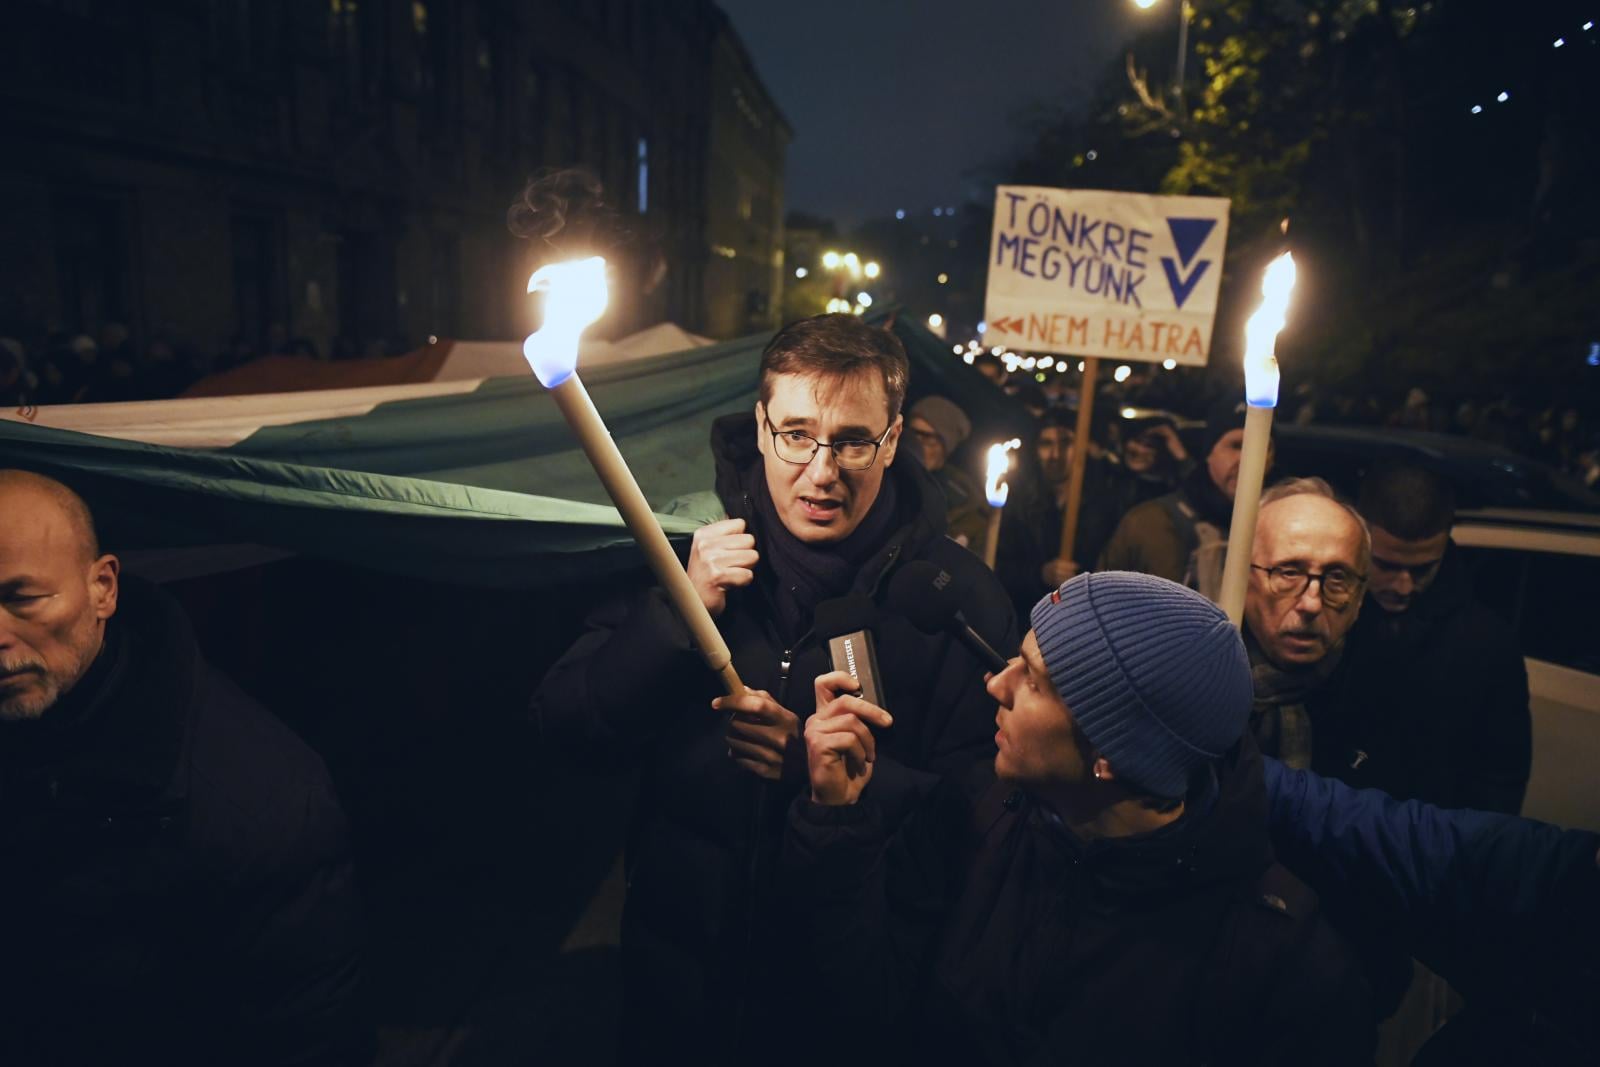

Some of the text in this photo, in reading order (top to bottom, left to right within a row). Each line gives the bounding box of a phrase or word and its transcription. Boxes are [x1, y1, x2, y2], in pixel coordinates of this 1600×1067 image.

[1006, 193, 1153, 268] TÖNKRE
[996, 232, 1146, 308] MEGYÜNK
[1028, 312, 1089, 347] NEM
[844, 639, 858, 680] NNHEISER
